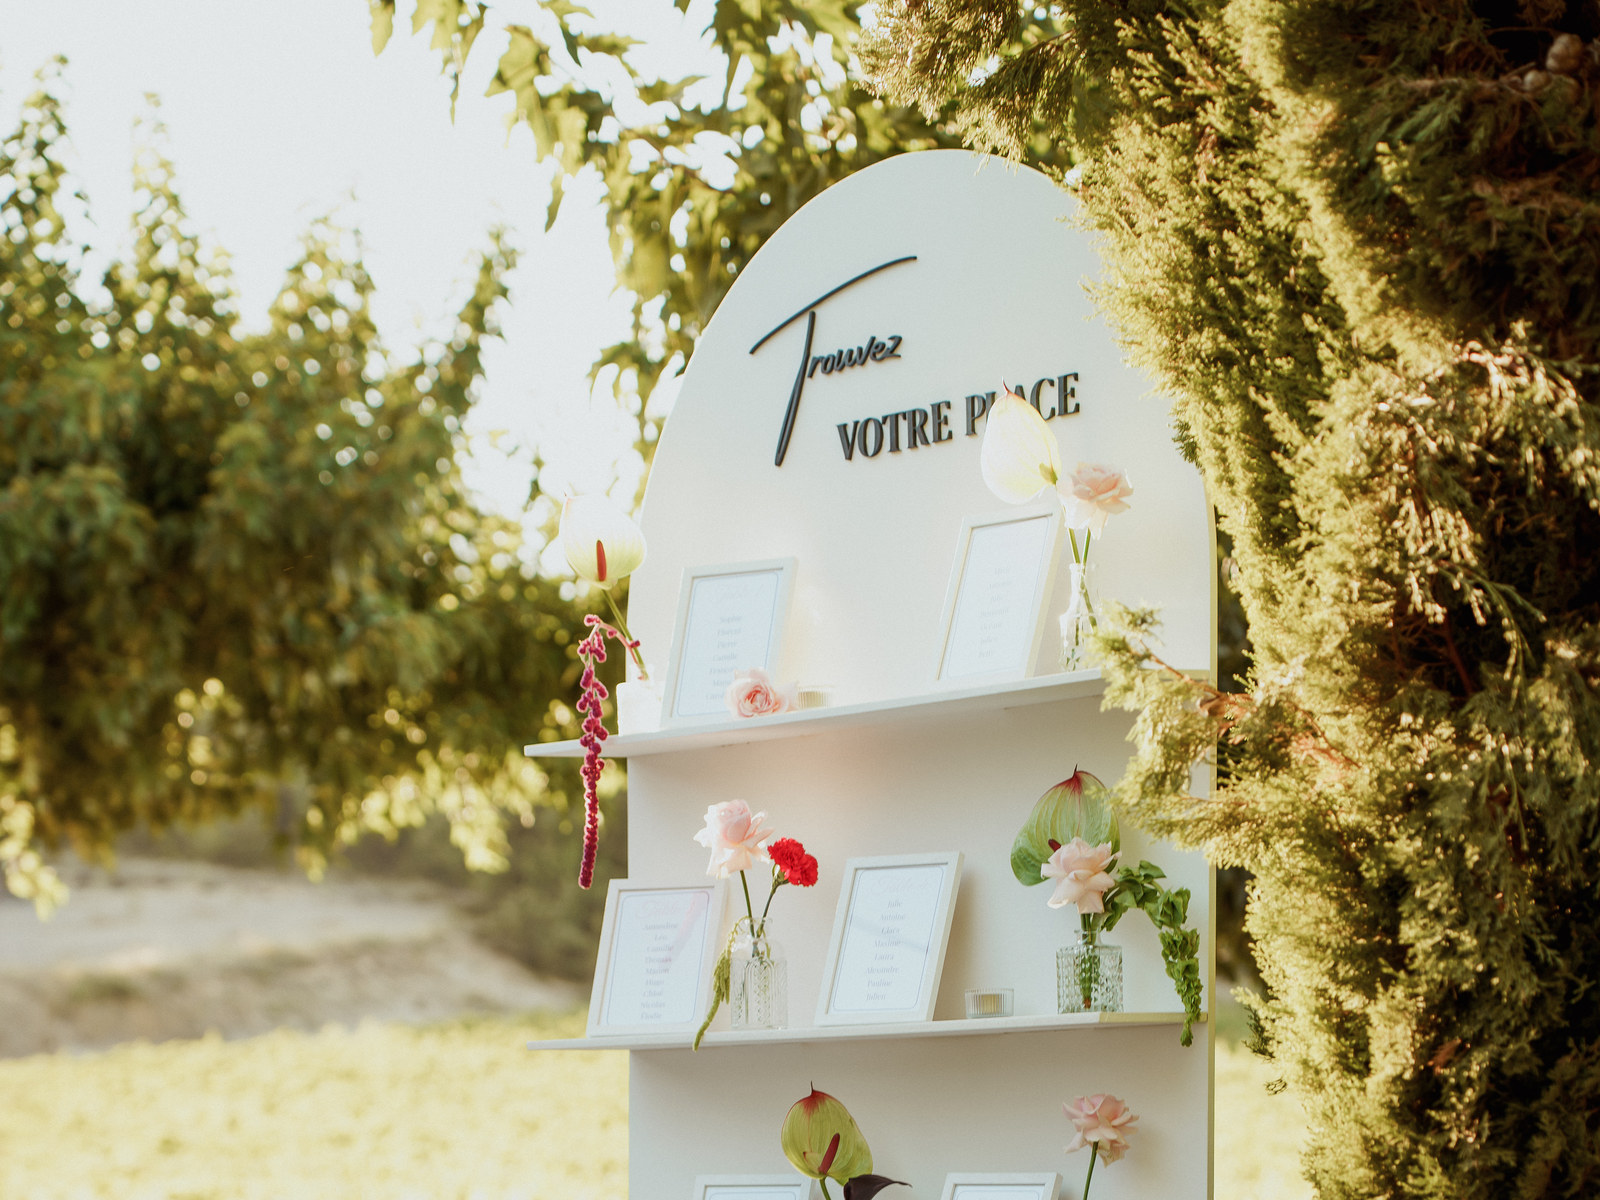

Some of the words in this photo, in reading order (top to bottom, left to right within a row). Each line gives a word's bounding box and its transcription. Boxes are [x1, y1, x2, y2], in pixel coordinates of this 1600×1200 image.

[749, 255, 918, 467] Trouvez
[837, 400, 953, 462] VOTRE
[874, 953, 895, 961] Laura
